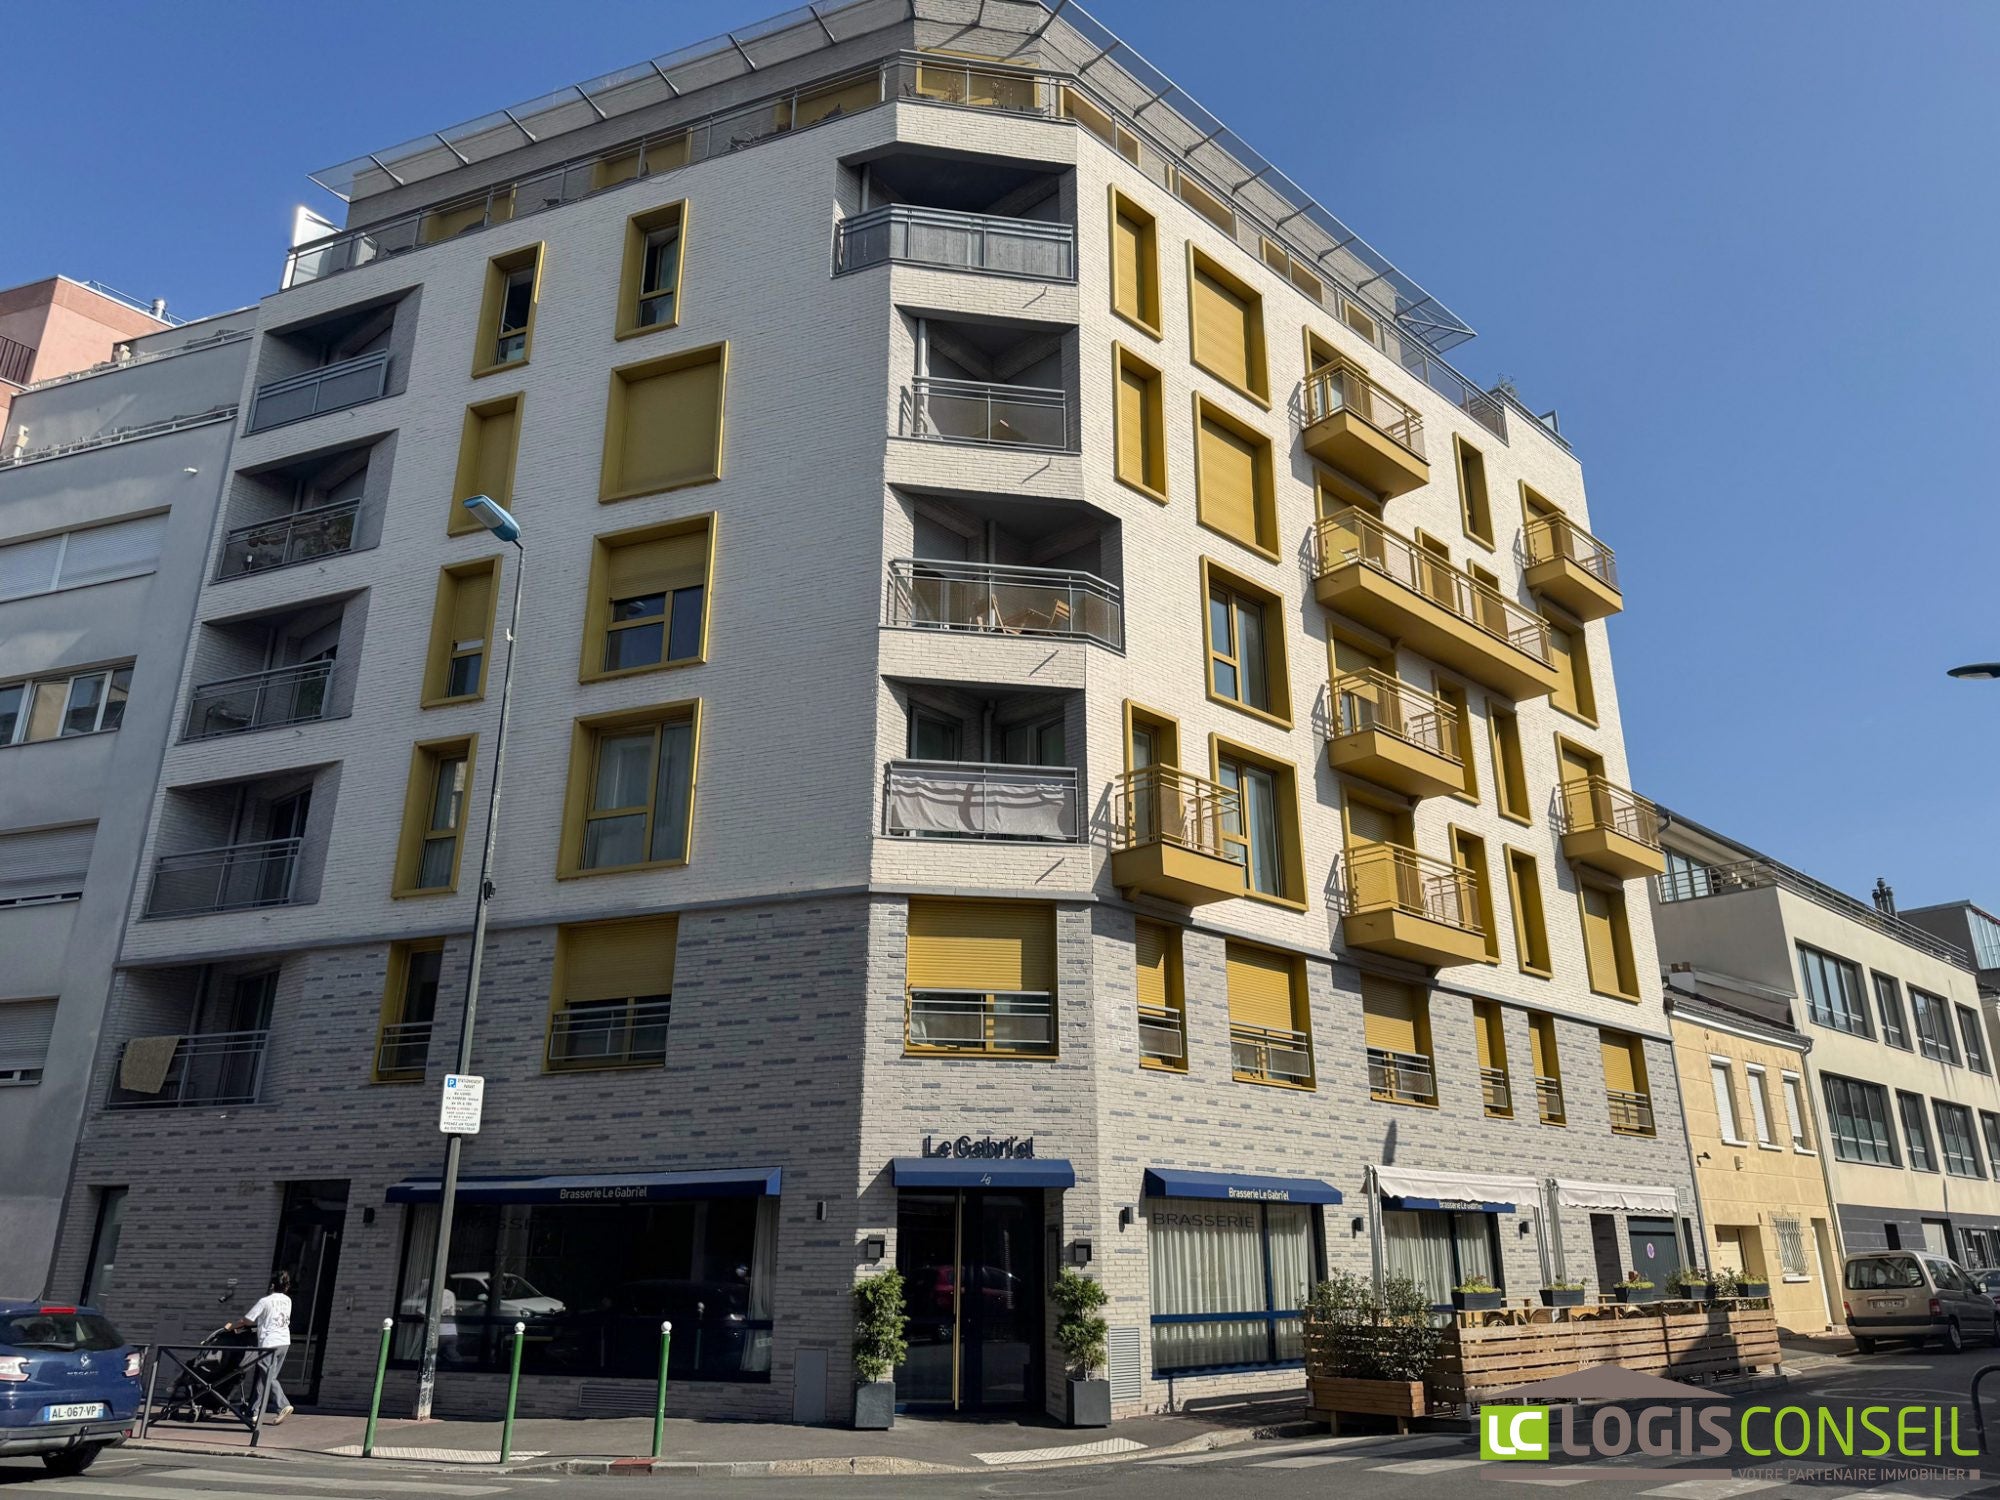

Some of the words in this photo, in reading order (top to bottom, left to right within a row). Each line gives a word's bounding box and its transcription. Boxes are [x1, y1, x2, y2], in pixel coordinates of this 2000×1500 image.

[922, 1135, 952, 1158] Le
[560, 1188, 602, 1199] Brasserie
[603, 1187, 614, 1198] Le
[1228, 1187, 1259, 1200] Brasserie
[1259, 1189, 1267, 1200] Le
[1153, 1213, 1255, 1228] BRASSERIE
